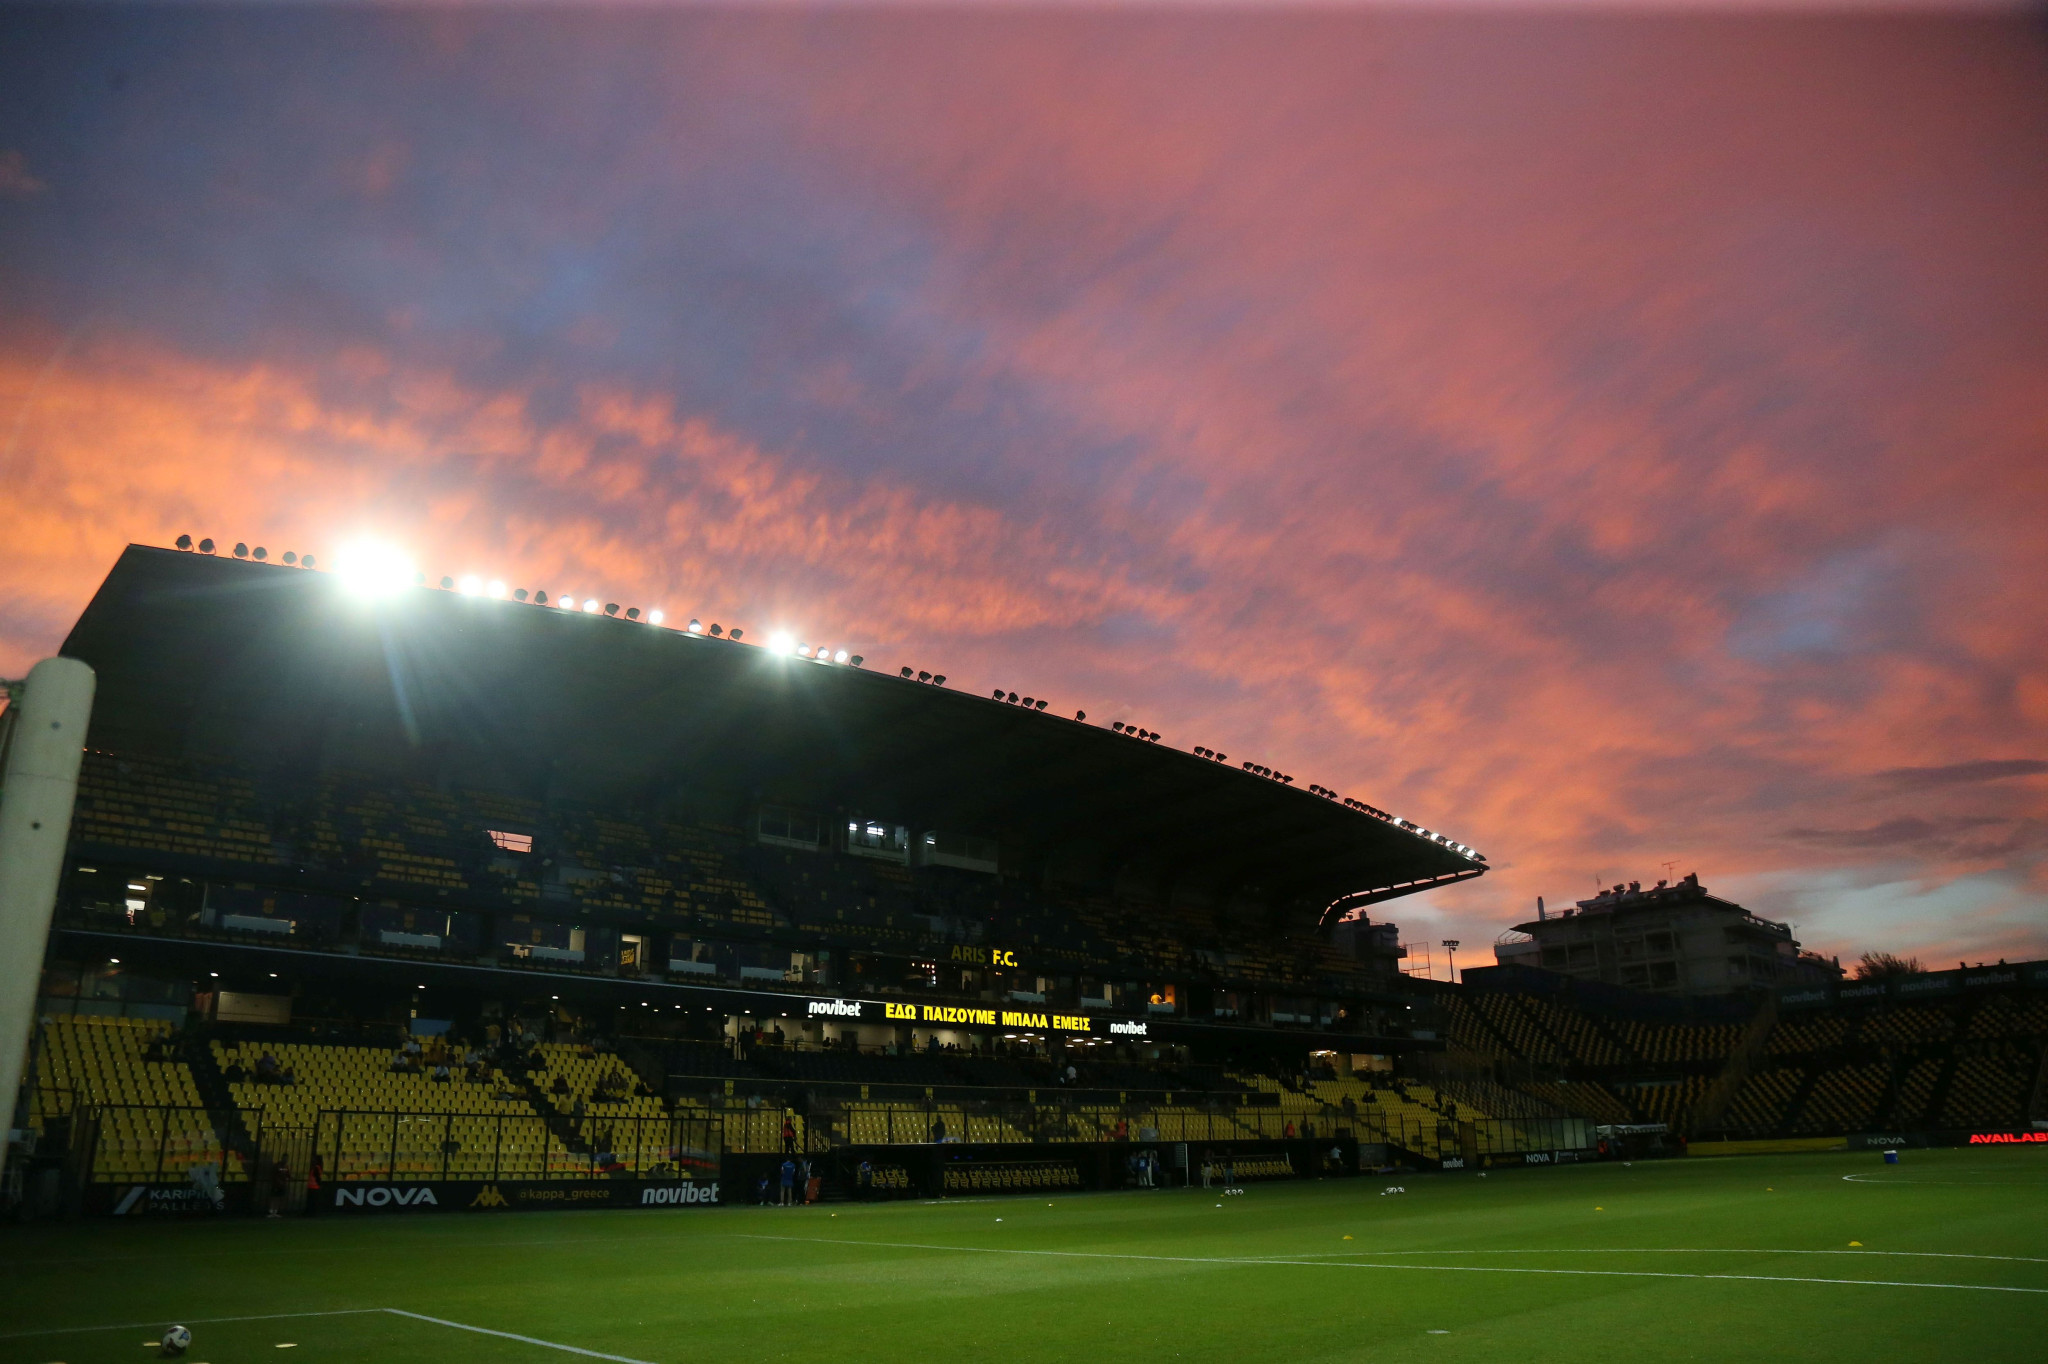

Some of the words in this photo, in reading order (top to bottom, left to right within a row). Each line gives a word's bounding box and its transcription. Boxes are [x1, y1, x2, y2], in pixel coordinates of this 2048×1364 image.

[951, 944, 987, 963] ARIS
[992, 949, 1018, 967] F.C.
[1901, 979, 1949, 991] novibet
[1965, 971, 2017, 985] novibet
[808, 1000, 861, 1016] novibet
[885, 1002, 917, 1020] ΕΔΩ
[923, 1005, 996, 1025] ΠΑΙΖΟΥΜΕ
[1002, 1011, 1049, 1029] ΜΠΑΛΑ
[1052, 1015, 1091, 1032] ΕΜΕΙΣ
[1110, 1021, 1148, 1036] novibet
[1867, 1137, 1906, 1145] NOVA
[1442, 1157, 1464, 1169] novibet
[1526, 1153, 1550, 1163] NOVA
[335, 1187, 438, 1207] NOVA
[641, 1181, 720, 1205] novibet
